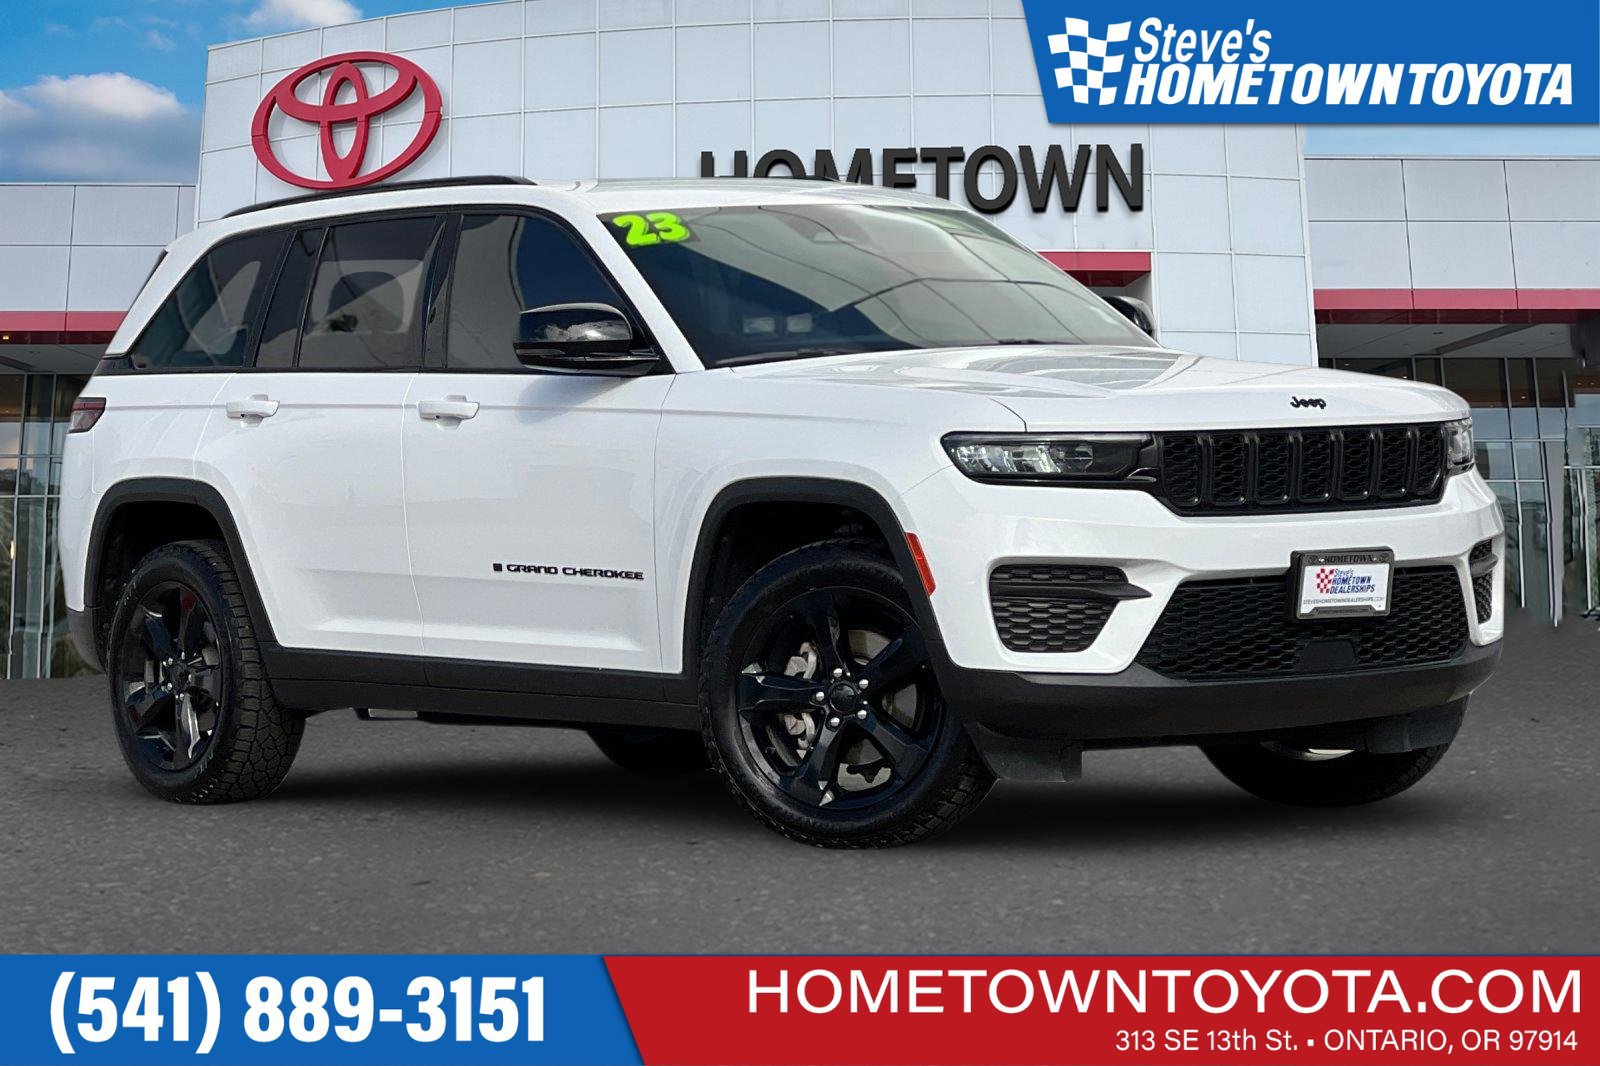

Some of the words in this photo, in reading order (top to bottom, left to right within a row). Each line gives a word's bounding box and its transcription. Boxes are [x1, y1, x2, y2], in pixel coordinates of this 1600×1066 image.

[612, 211, 690, 246] 23
[1290, 396, 1327, 410] Jeep
[1325, 554, 1373, 563] HOMETOWN
[506, 563, 558, 575] GRAND
[562, 566, 645, 581] CHEROKEE
[1333, 568, 1354, 577] Steve's
[1331, 575, 1372, 585] HOMETOWN
[1329, 584, 1376, 594] DEALERSHIPS
